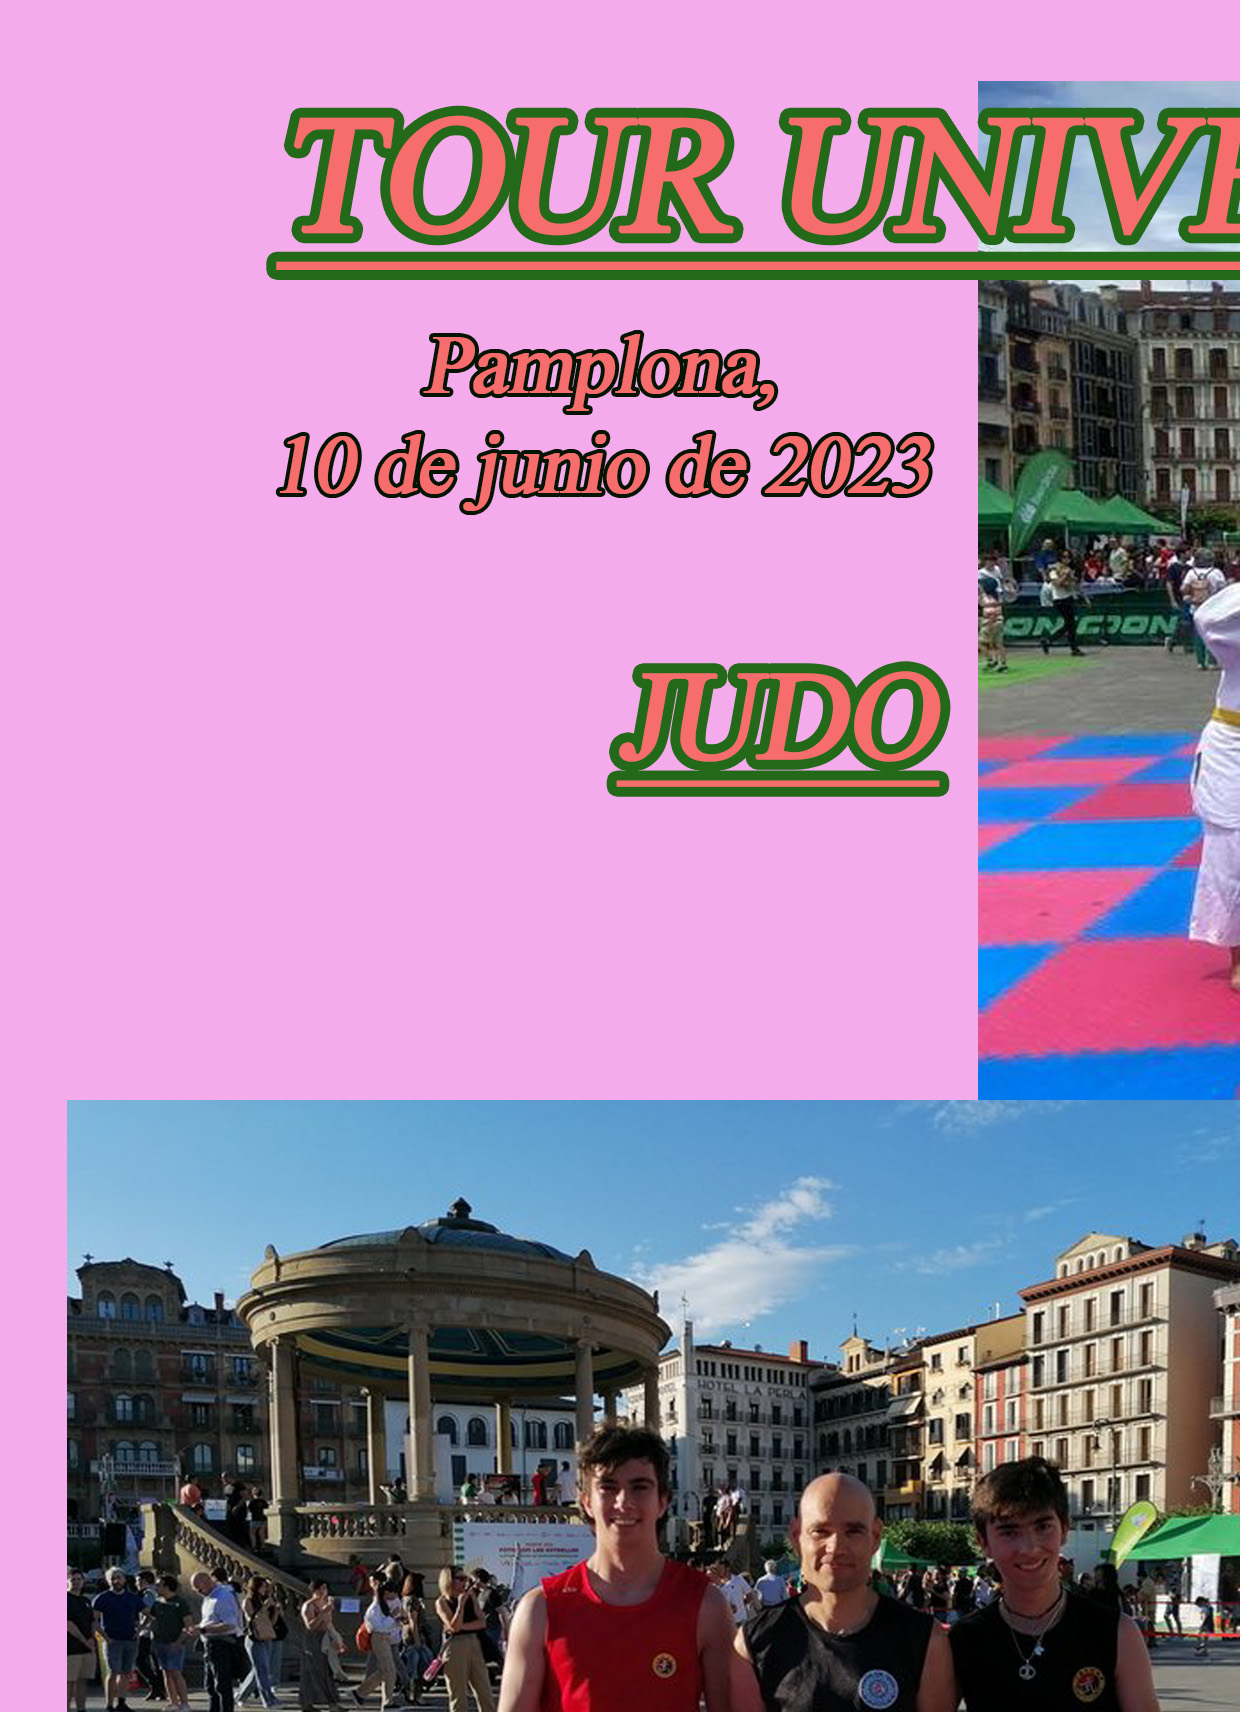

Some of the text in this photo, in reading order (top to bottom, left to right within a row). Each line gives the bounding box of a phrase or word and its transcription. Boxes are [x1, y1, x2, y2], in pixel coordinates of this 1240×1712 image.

[697, 1379, 806, 1400] HOTEL LA PERLA
